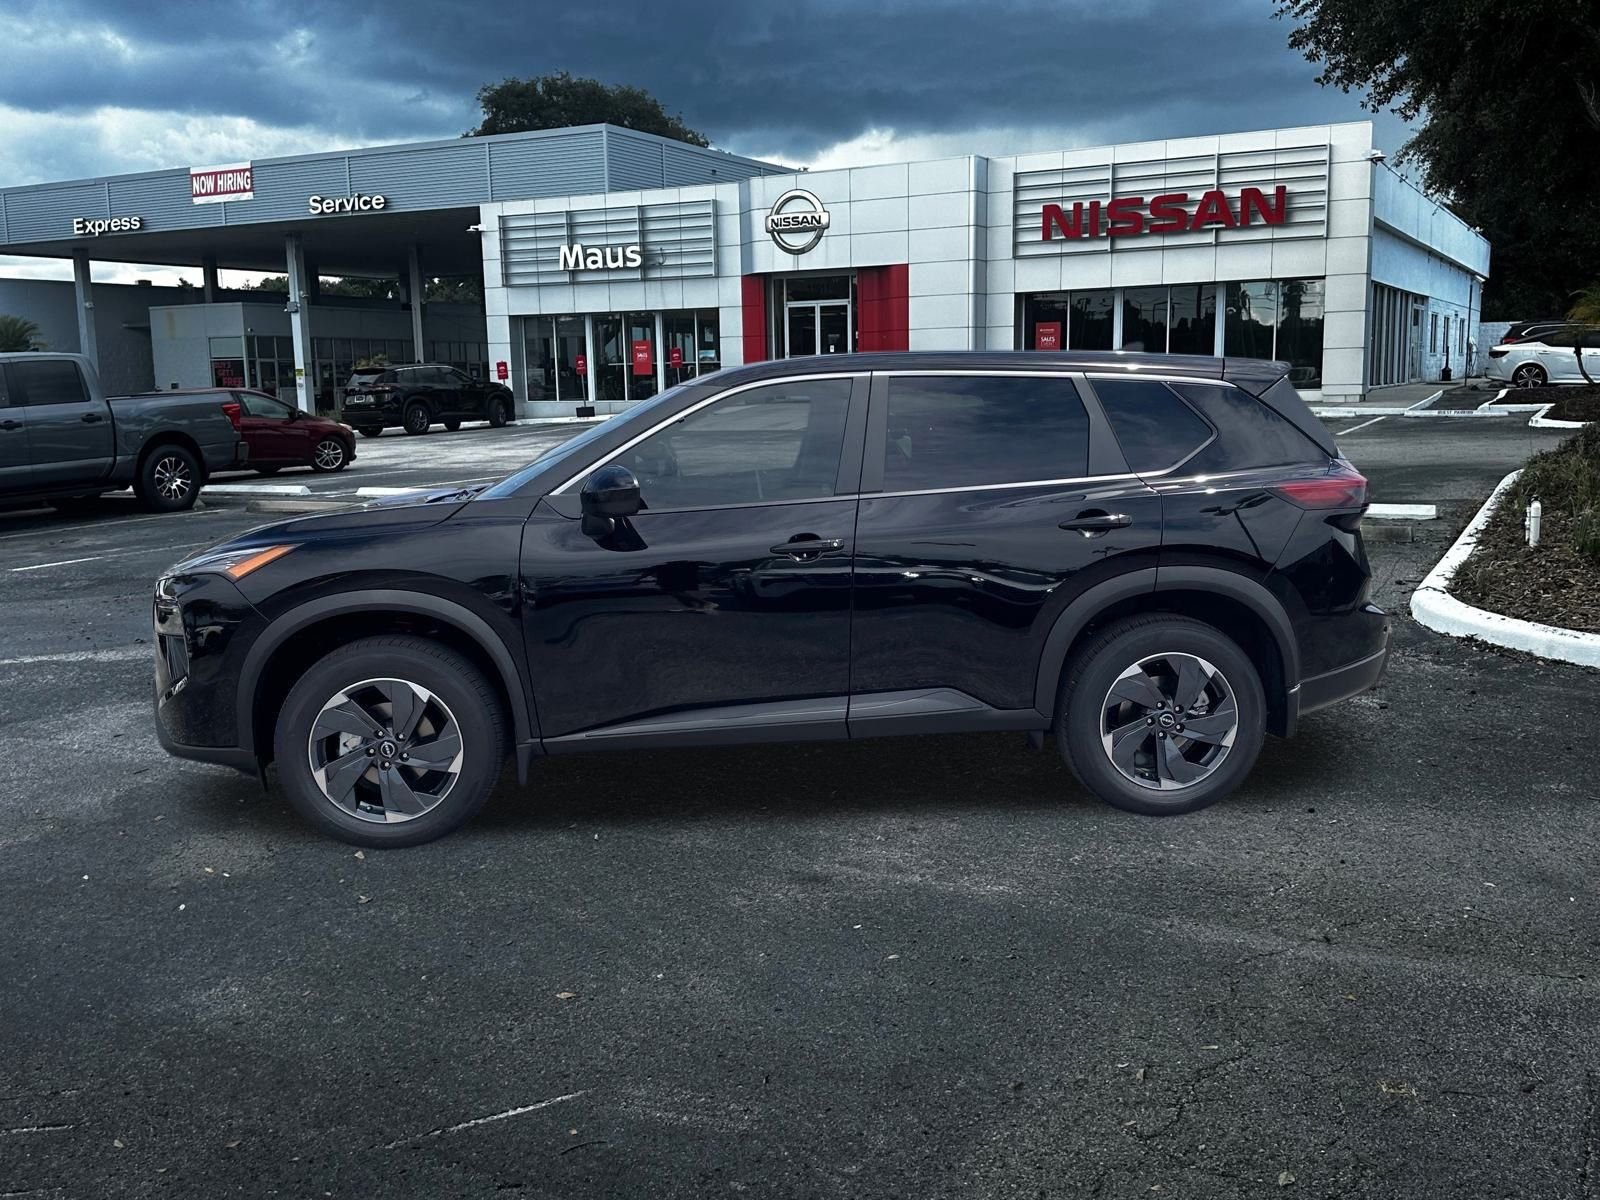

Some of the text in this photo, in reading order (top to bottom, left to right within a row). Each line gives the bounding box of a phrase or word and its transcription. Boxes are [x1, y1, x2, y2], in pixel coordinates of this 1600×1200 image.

[192, 171, 251, 195] NOW HIRING
[309, 193, 385, 214] Service
[1042, 185, 1286, 241] NISSAN
[73, 216, 141, 236] Express
[771, 215, 822, 228] NISSAN
[559, 243, 642, 270] Maus
